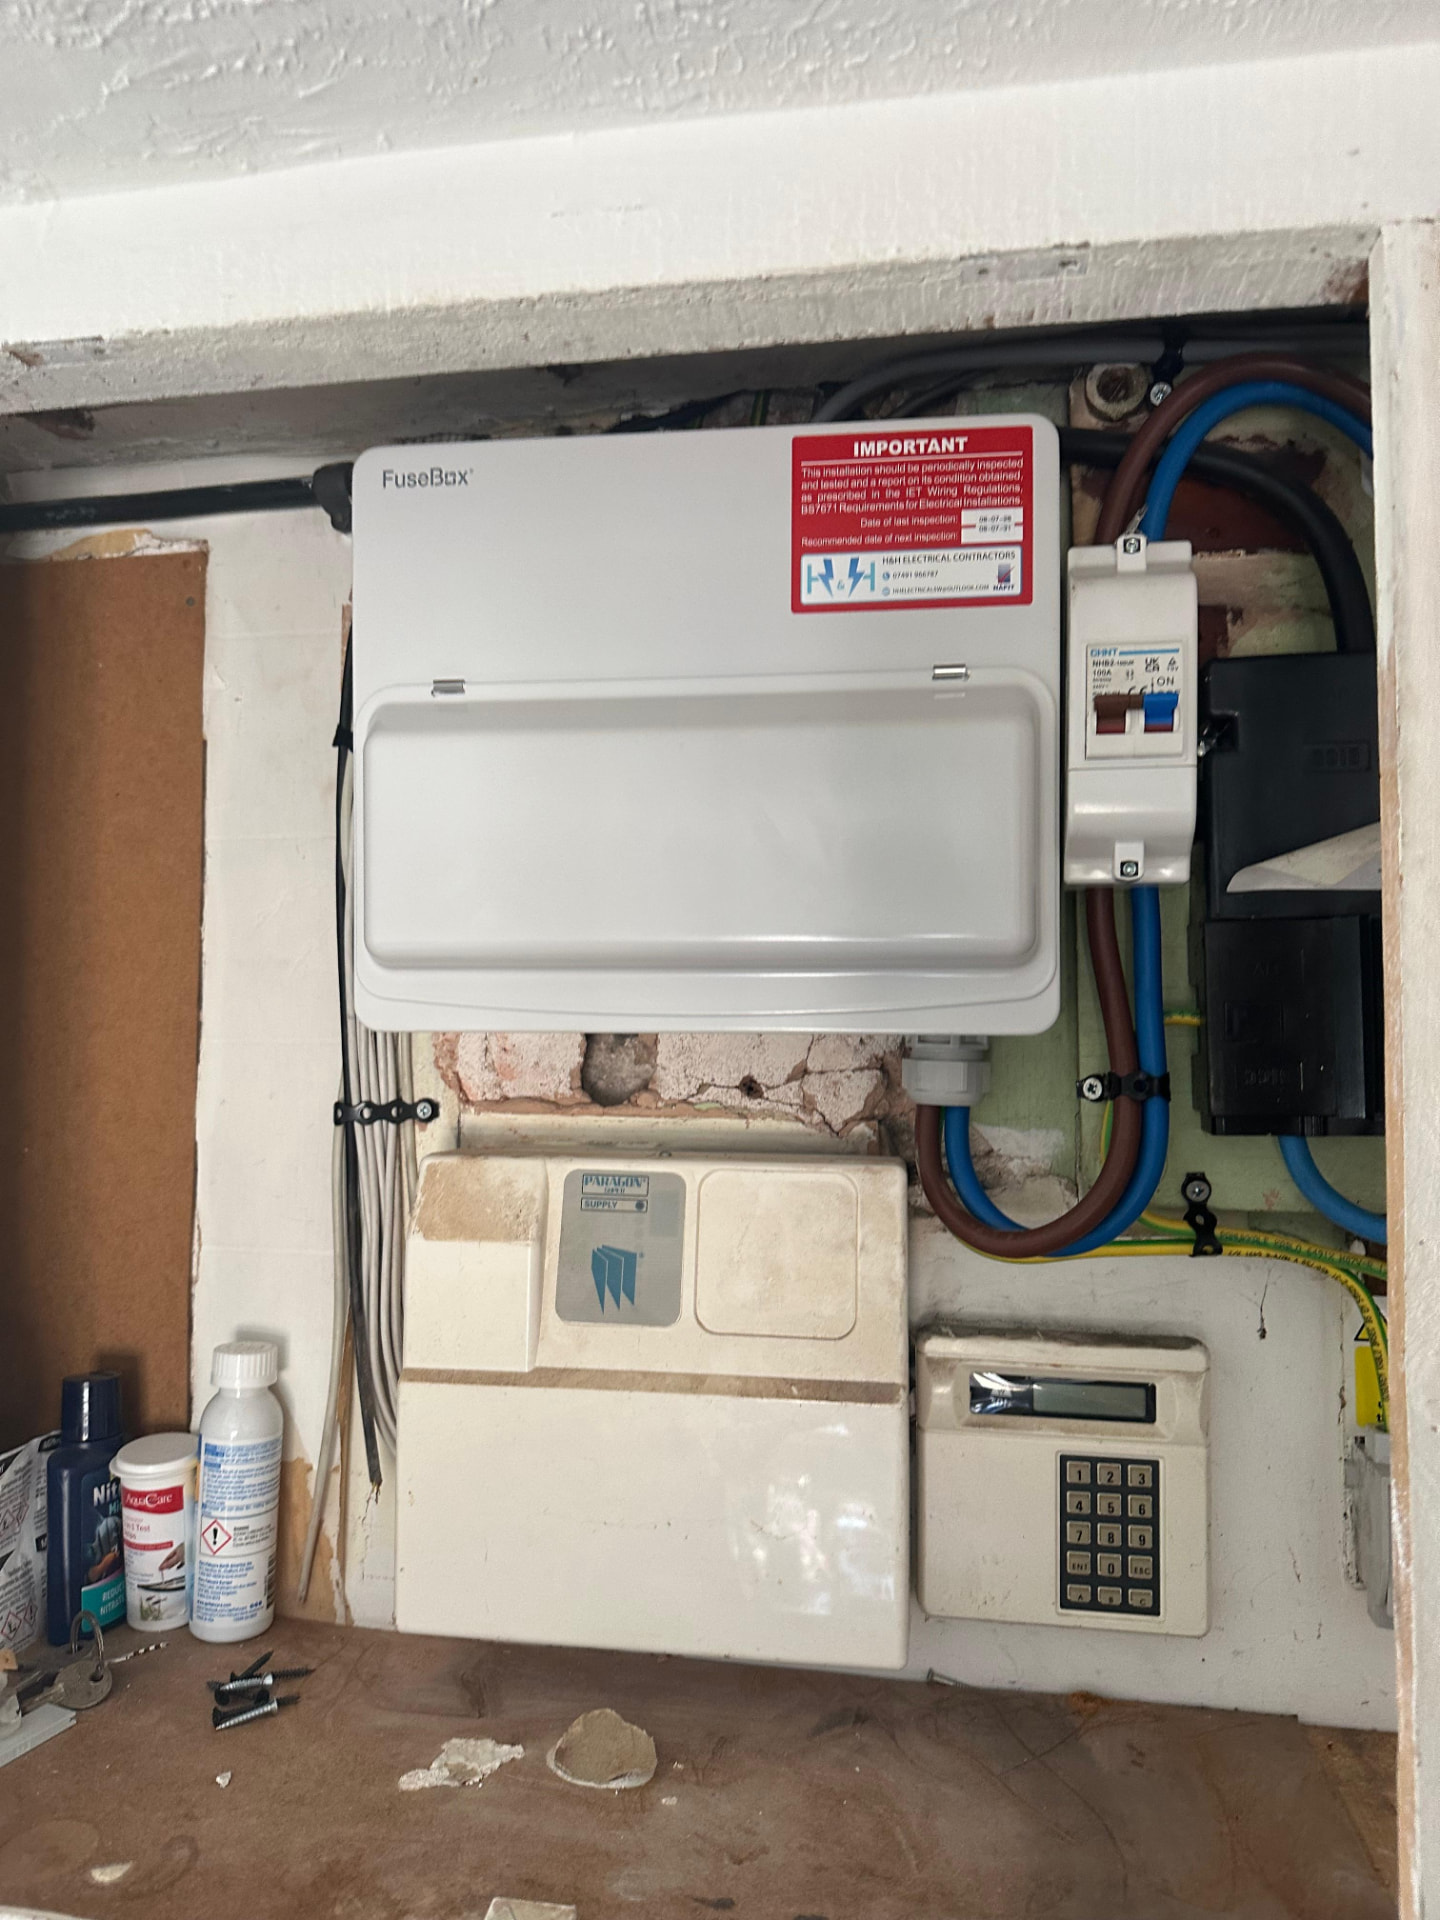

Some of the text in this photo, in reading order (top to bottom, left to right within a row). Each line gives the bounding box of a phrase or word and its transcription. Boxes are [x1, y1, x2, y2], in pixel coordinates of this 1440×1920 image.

[853, 436, 968, 457] IMPORTANT
[801, 457, 1024, 478] This installation should be periodically inspected
[382, 467, 469, 489] FuseBox
[801, 470, 1024, 491] and tested and a report on its condition obtained,
[801, 482, 1023, 505] as prescribed in the IET Wiring Regulations,
[801, 495, 1022, 515] BS7671 Requirements for Electrical Installations.
[861, 517, 881, 527] Date
[883, 517, 892, 527] of
[894, 516, 910, 526] last
[911, 513, 958, 528] inspection:
[801, 531, 958, 548] Recommended date of next inspection:
[882, 550, 1016, 566] H&H ELECTRICAL CONTRACTORS
[1093, 669, 1112, 677] 100A
[1156, 676, 1174, 687] ON
[583, 1175, 643, 1188] PARAGON
[584, 1201, 618, 1209] SUPPLY
[1077, 1469, 1145, 1485] 1 2 3
[93, 1482, 121, 1507] Nit
[126, 1493, 173, 1508] AquaCare
[1075, 1500, 1145, 1515] 4 5 6
[1076, 1530, 1145, 1546] 7 8 9
[1107, 1563, 1115, 1575] 0
[1134, 1566, 1150, 1575] ESC
[102, 1579, 124, 1602] REDUC
